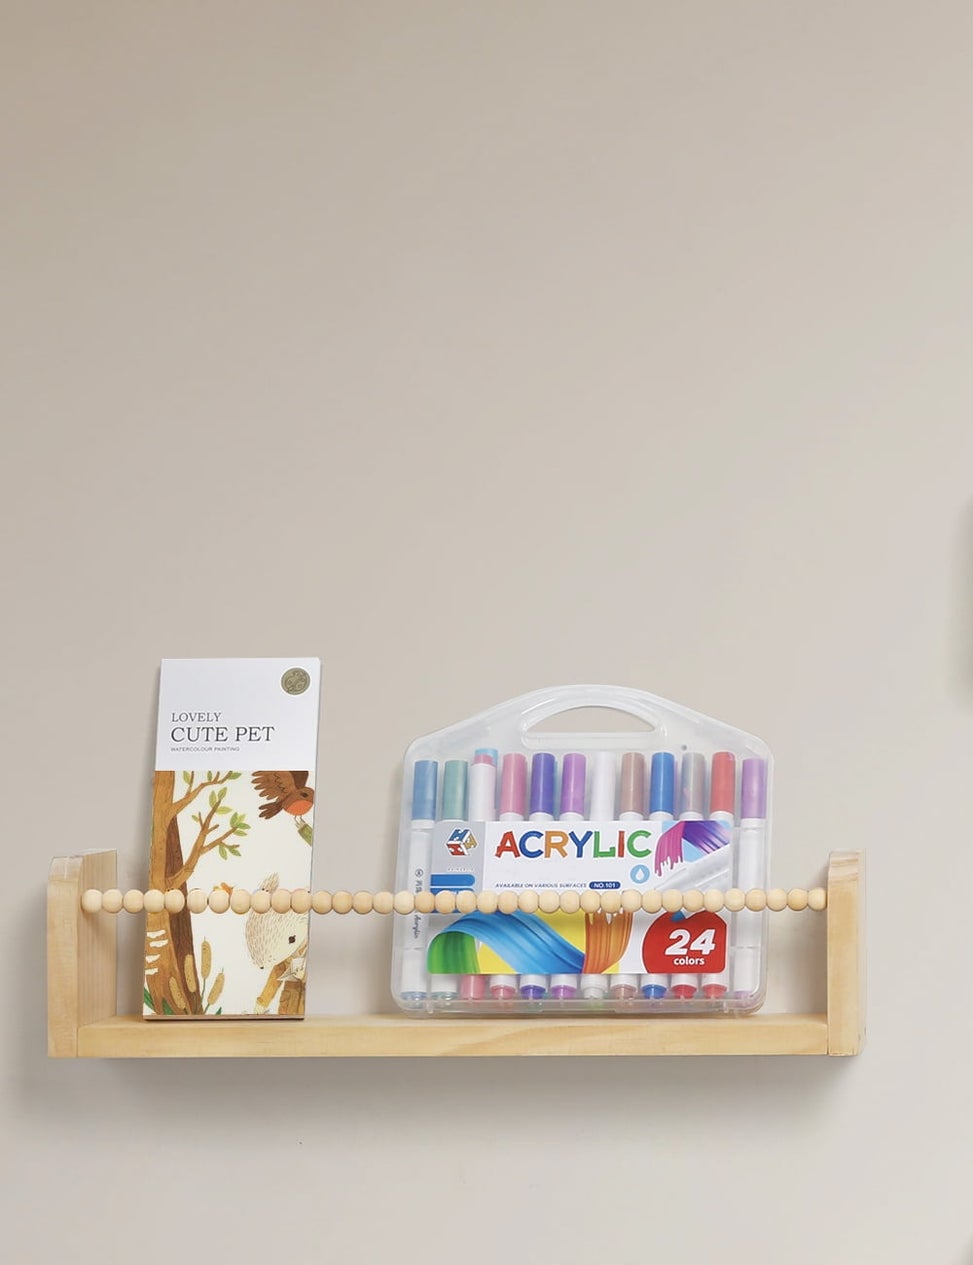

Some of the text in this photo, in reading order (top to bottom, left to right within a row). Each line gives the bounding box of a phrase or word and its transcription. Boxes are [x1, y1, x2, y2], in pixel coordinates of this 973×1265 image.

[171, 712, 222, 722] LOVELY
[170, 726, 275, 742] CUTE PET
[495, 830, 652, 859] ACRYLIC
[664, 928, 716, 956] 24
[673, 955, 705, 966] colors
